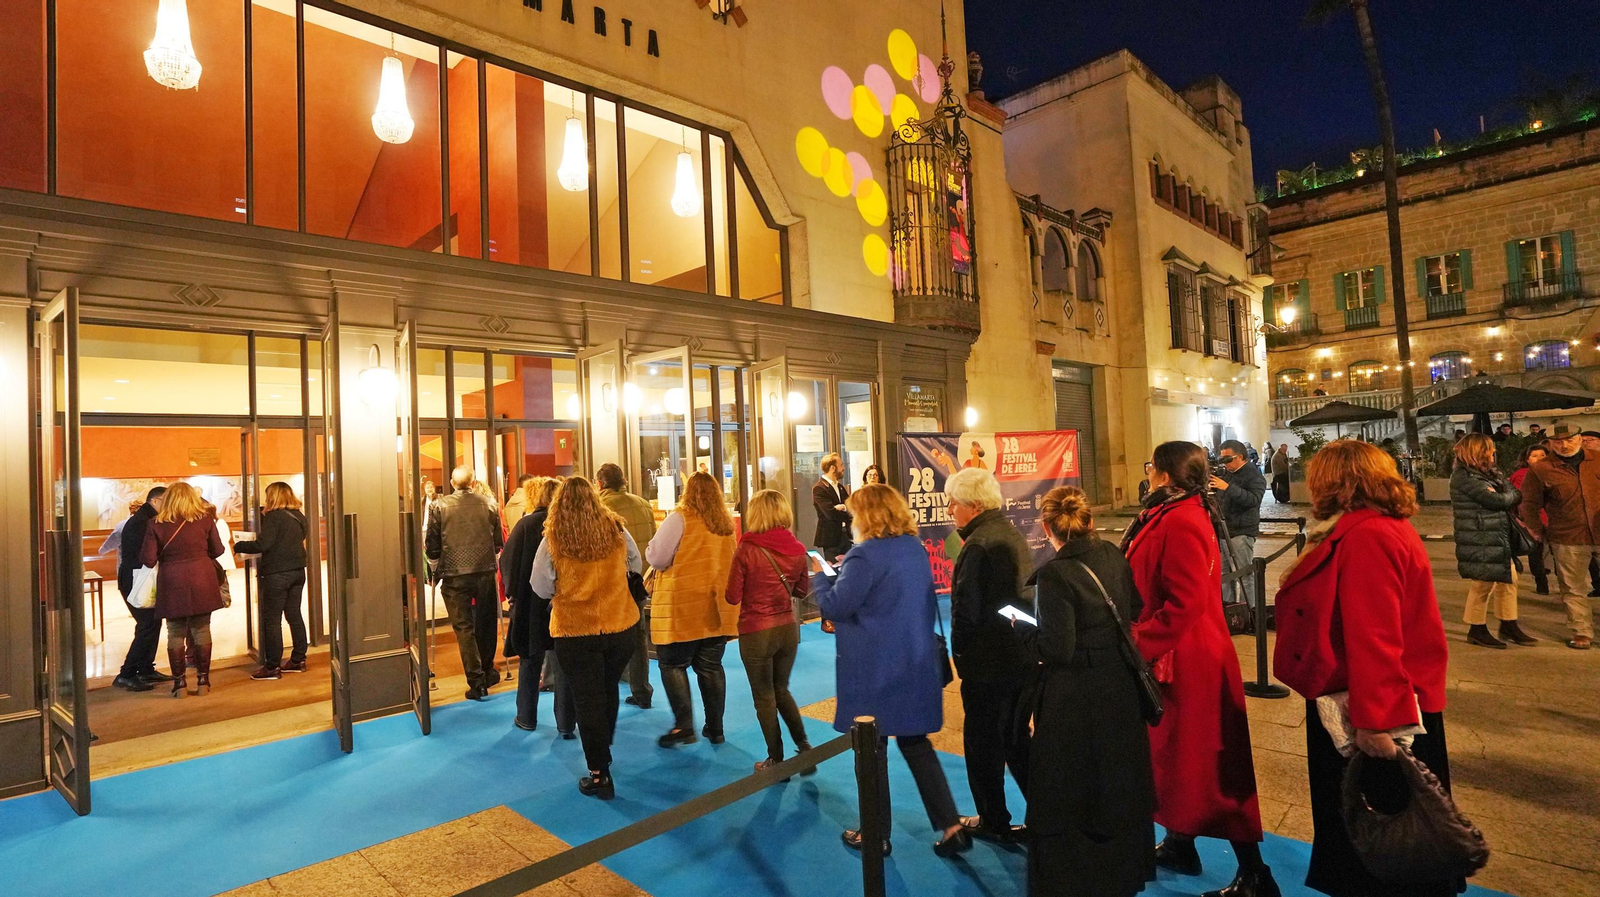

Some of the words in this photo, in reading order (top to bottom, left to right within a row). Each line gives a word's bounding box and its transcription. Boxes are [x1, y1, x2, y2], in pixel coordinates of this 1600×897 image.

[1002, 437, 1019, 453] 28
[1003, 453, 1037, 463] FESTIVAL
[1002, 464, 1013, 474] DE
[1014, 462, 1038, 473] JEREZ
[908, 467, 935, 493] 28
[908, 492, 951, 508] FESTIV
[909, 509, 927, 523] DE
[929, 507, 957, 523] JER
